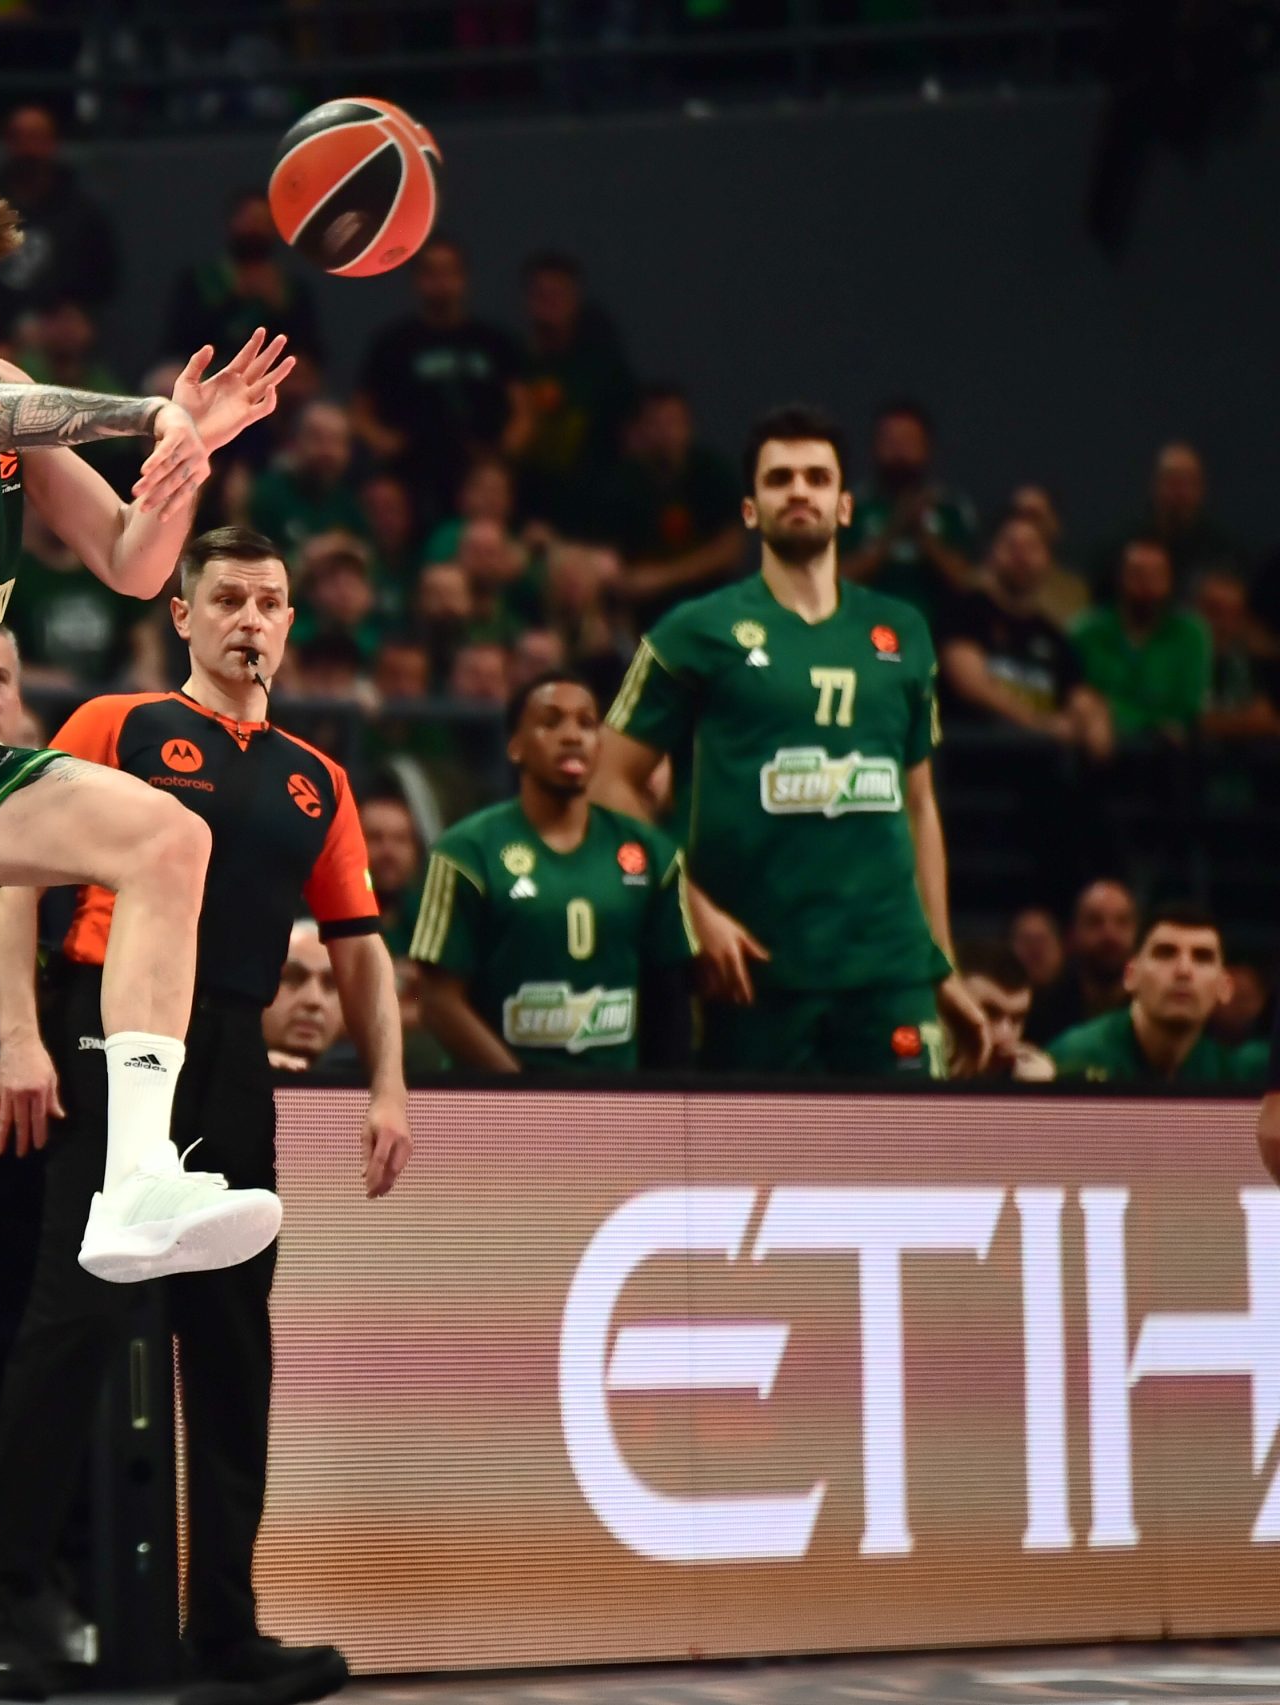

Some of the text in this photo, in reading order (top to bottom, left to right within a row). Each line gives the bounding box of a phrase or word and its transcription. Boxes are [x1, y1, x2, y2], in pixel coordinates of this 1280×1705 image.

[810, 667, 856, 728] 77
[149, 775, 215, 793] motorola
[567, 897, 595, 960] 0
[123, 1061, 167, 1073] adidas
[558, 1185, 1280, 1563] ETIH
